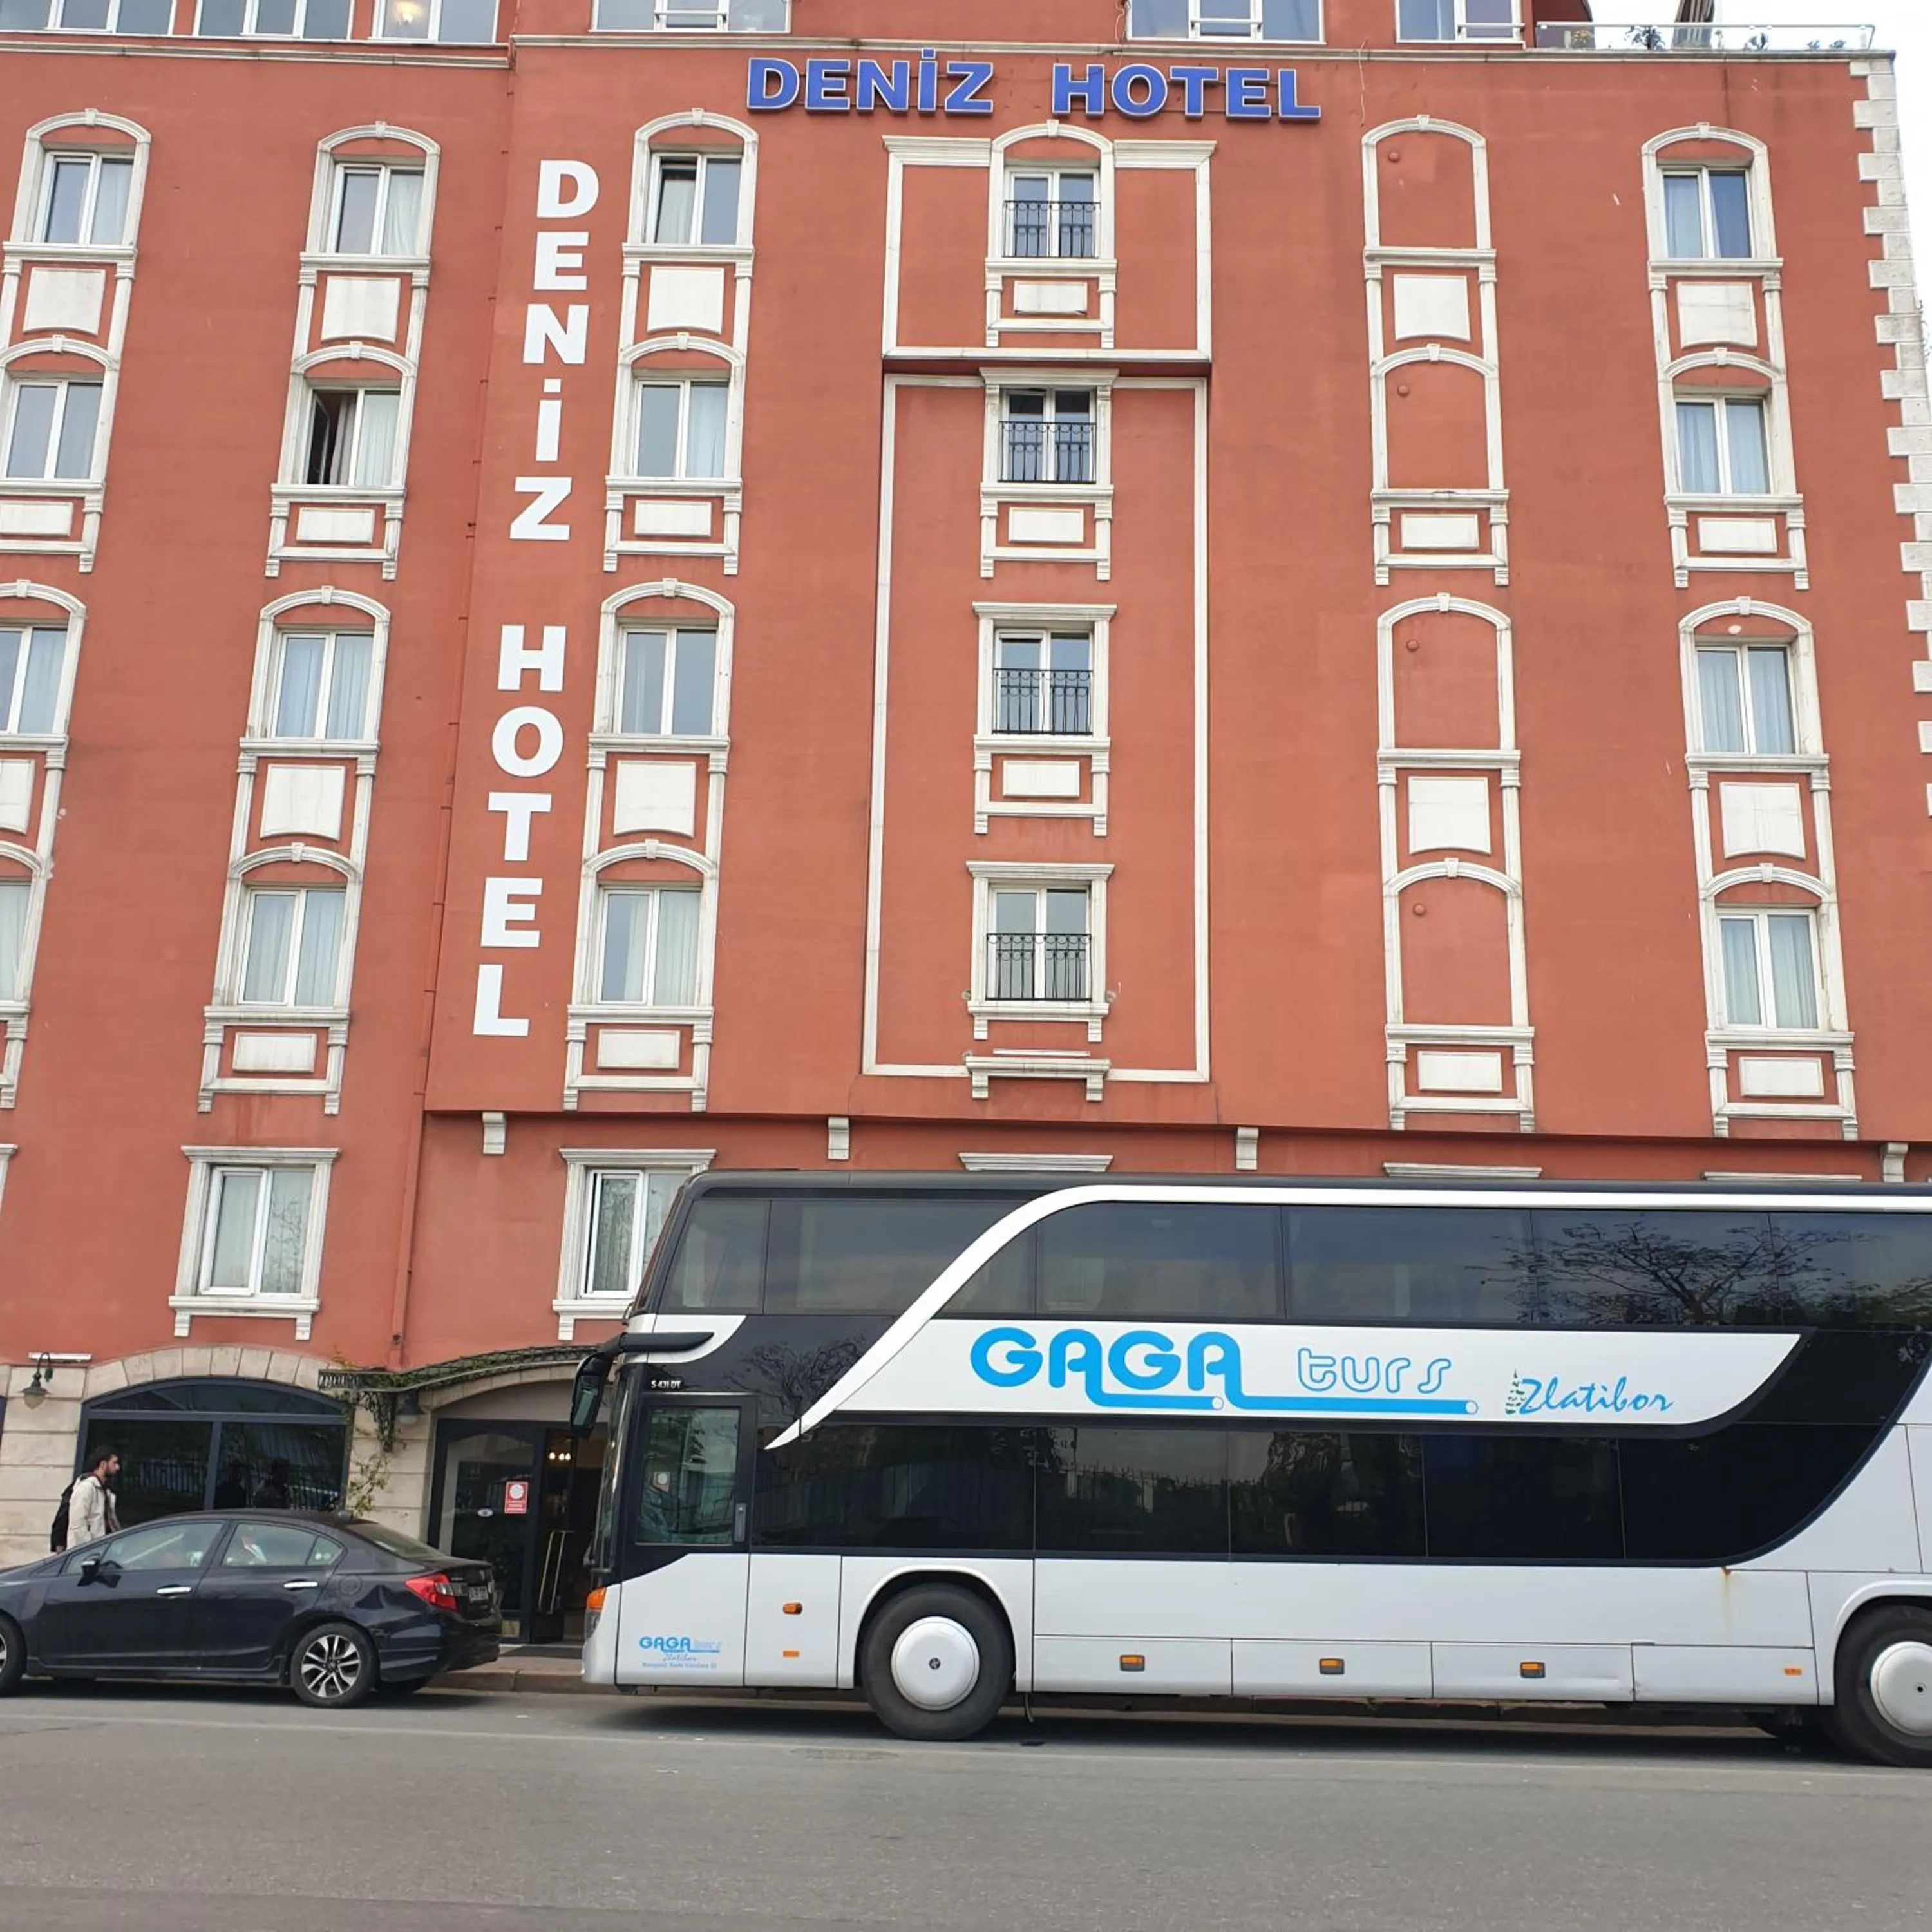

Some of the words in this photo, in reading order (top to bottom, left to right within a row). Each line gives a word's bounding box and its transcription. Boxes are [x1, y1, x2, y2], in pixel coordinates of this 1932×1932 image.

[746, 47, 994, 115] DENİZ
[1052, 62, 1321, 120] HOTEL
[473, 624, 567, 1036] HOTEL
[650, 1379, 657, 1389] S
[969, 1326, 1247, 1410] GAGA
[1297, 1347, 1452, 1395] turs
[1518, 1376, 1674, 1416] Zlatibor
[639, 1636, 691, 1652] GAGA
